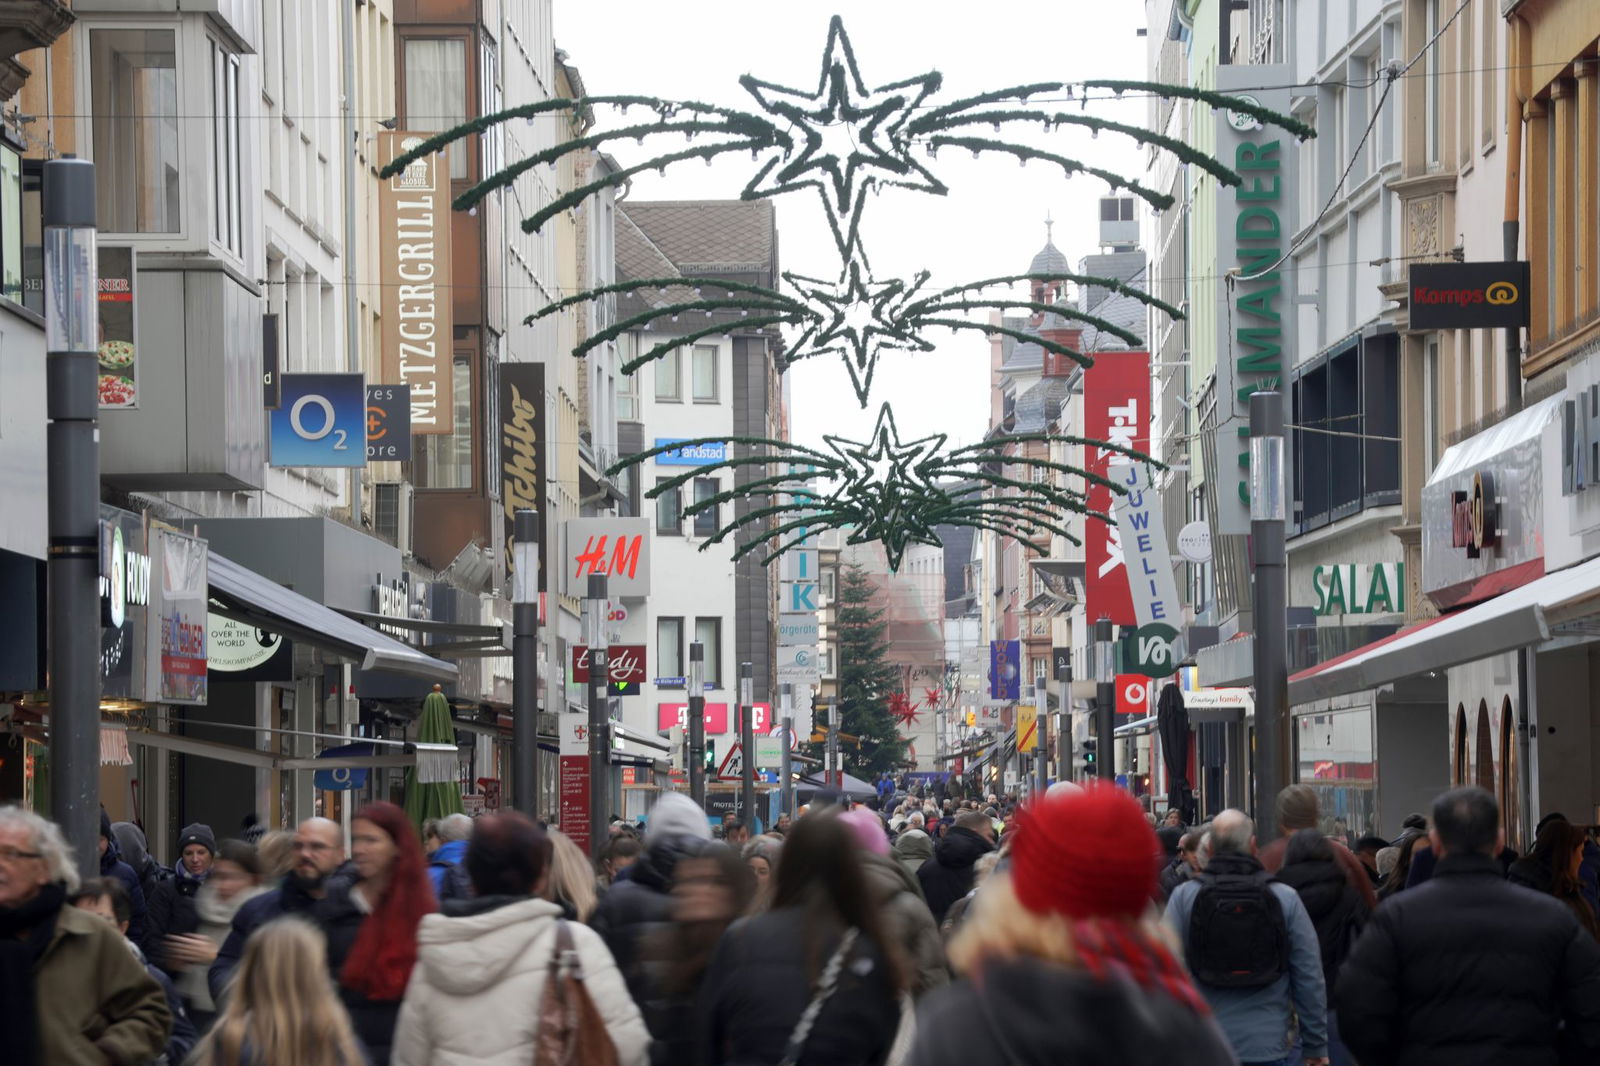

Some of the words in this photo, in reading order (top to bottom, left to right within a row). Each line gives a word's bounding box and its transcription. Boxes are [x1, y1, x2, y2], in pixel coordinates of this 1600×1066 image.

[396, 195, 437, 425] METZGERGRILL
[1414, 286, 1485, 308] Kamps
[290, 394, 348, 450] O2
[503, 384, 537, 521] Tchibo
[126, 551, 151, 606] FOODY
[575, 534, 643, 580] H&M
[211, 630, 233, 638] OVER
[236, 630, 250, 638] THE
[216, 639, 246, 647] WORLD
[1219, 695, 1243, 704] family
